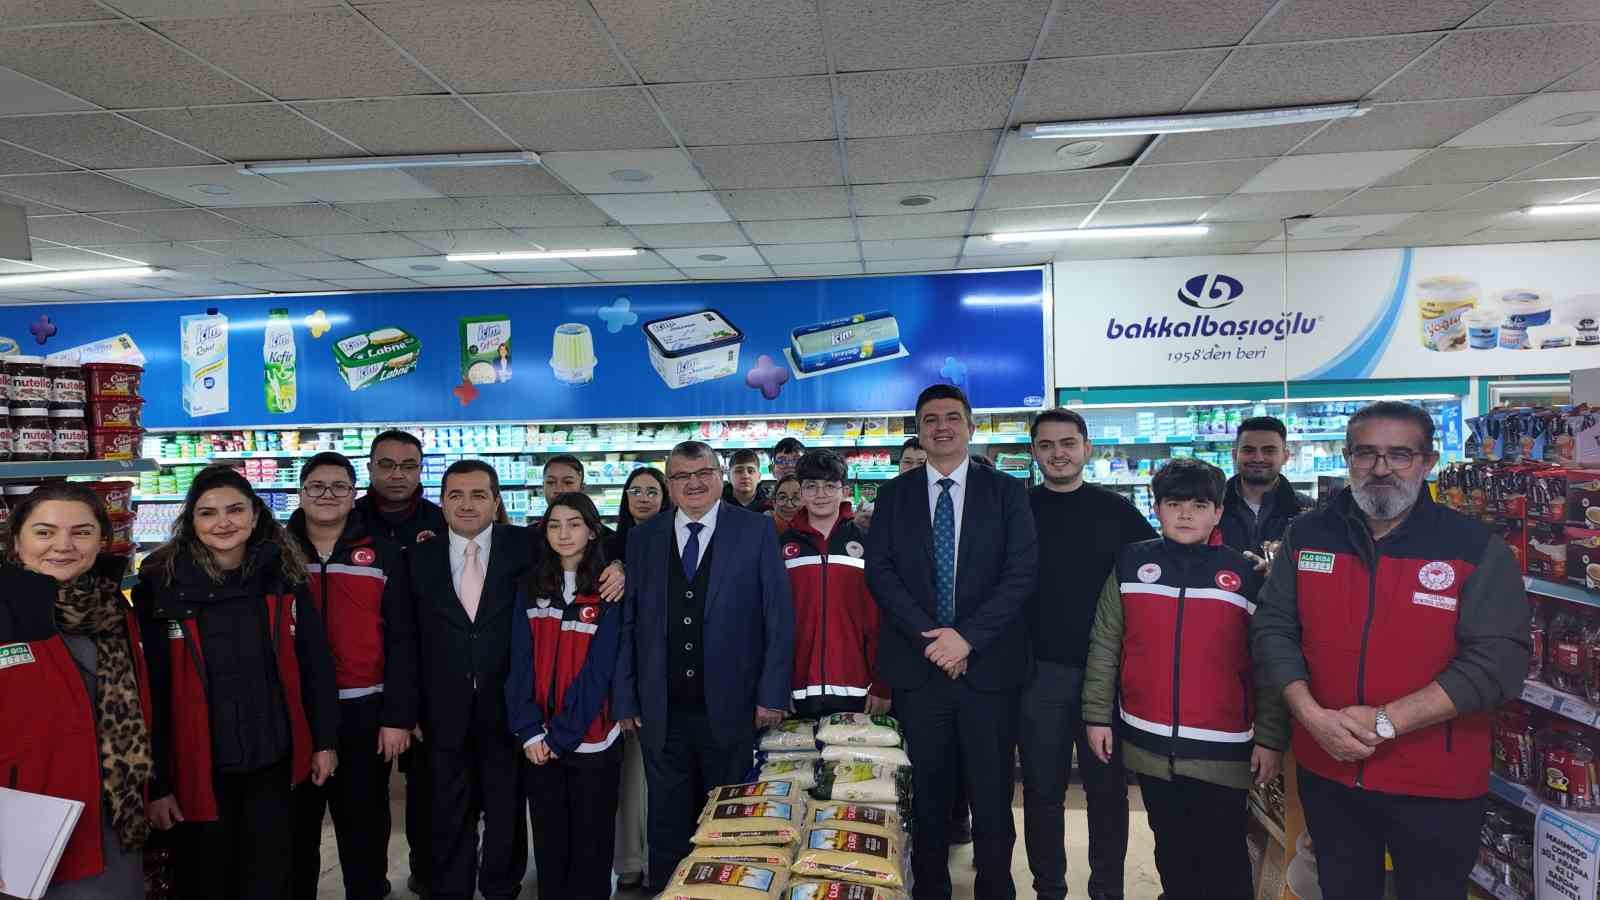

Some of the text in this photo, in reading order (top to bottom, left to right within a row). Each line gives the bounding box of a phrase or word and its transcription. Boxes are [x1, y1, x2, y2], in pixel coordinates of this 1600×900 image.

[1106, 312, 1317, 341] bakkalbaşıoğlu
[269, 350, 294, 365] Kefir
[1167, 346, 1267, 363] 1958'den beri
